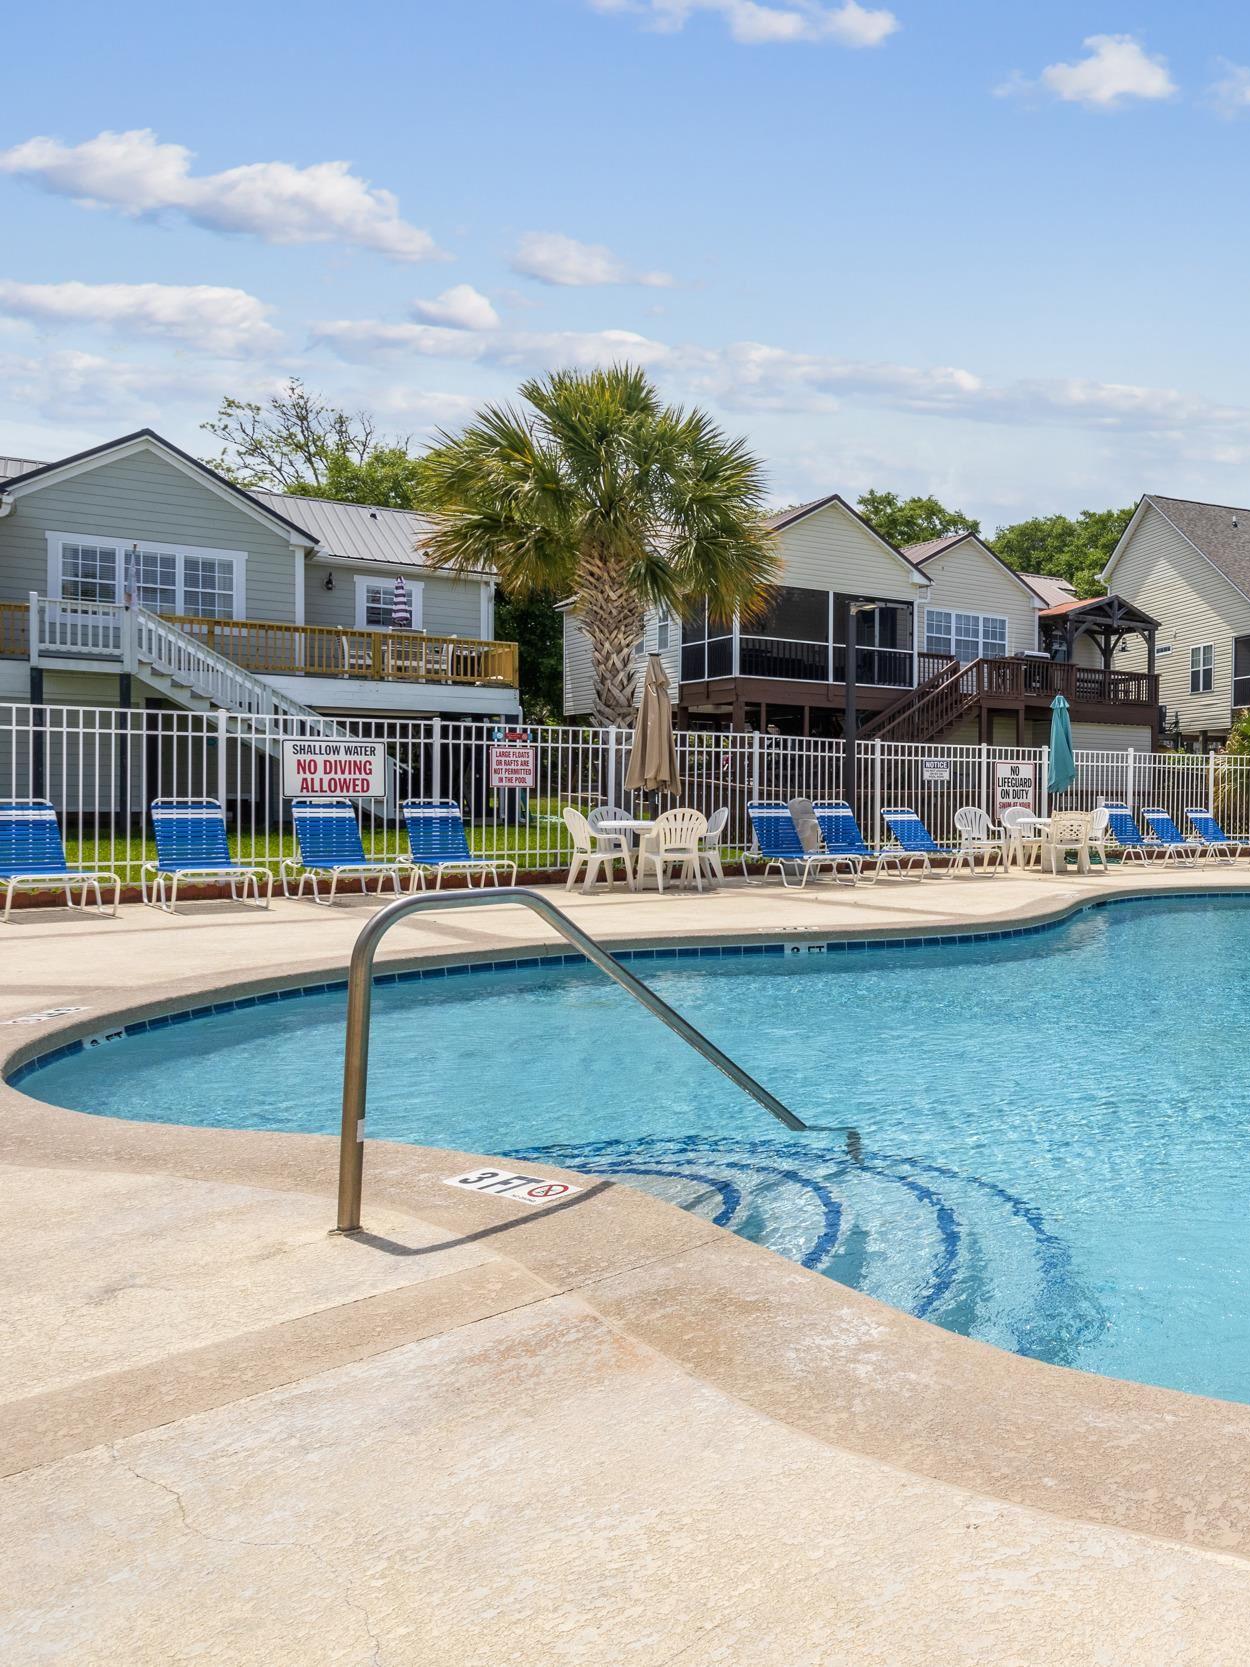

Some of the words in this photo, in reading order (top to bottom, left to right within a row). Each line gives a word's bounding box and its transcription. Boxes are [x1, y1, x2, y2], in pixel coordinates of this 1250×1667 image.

[292, 743, 340, 756] SHALLOW
[344, 745, 376, 757] WATER
[495, 750, 511, 758] LARGE
[512, 751, 530, 759] FLOATS
[296, 759, 318, 775] NO
[323, 759, 373, 776] DIVING
[495, 759, 503, 767] OR
[503, 759, 520, 767] RAFTS
[925, 761, 948, 769] NOTICE
[493, 767, 503, 775] NOT
[504, 768, 532, 776] PERMITTED
[1010, 765, 1020, 776] NO
[300, 777, 371, 794] ALLOWED
[498, 776, 504, 784] IN
[504, 776, 514, 784] THE
[514, 776, 527, 784] POOL
[997, 777, 1033, 788] LIFEGUARD
[1000, 788, 1010, 800] ON
[1012, 788, 1030, 800] DUTY
[998, 801, 1012, 809] SWIM
[458, 1171, 500, 1185] 3
[476, 1174, 547, 1194] FT
